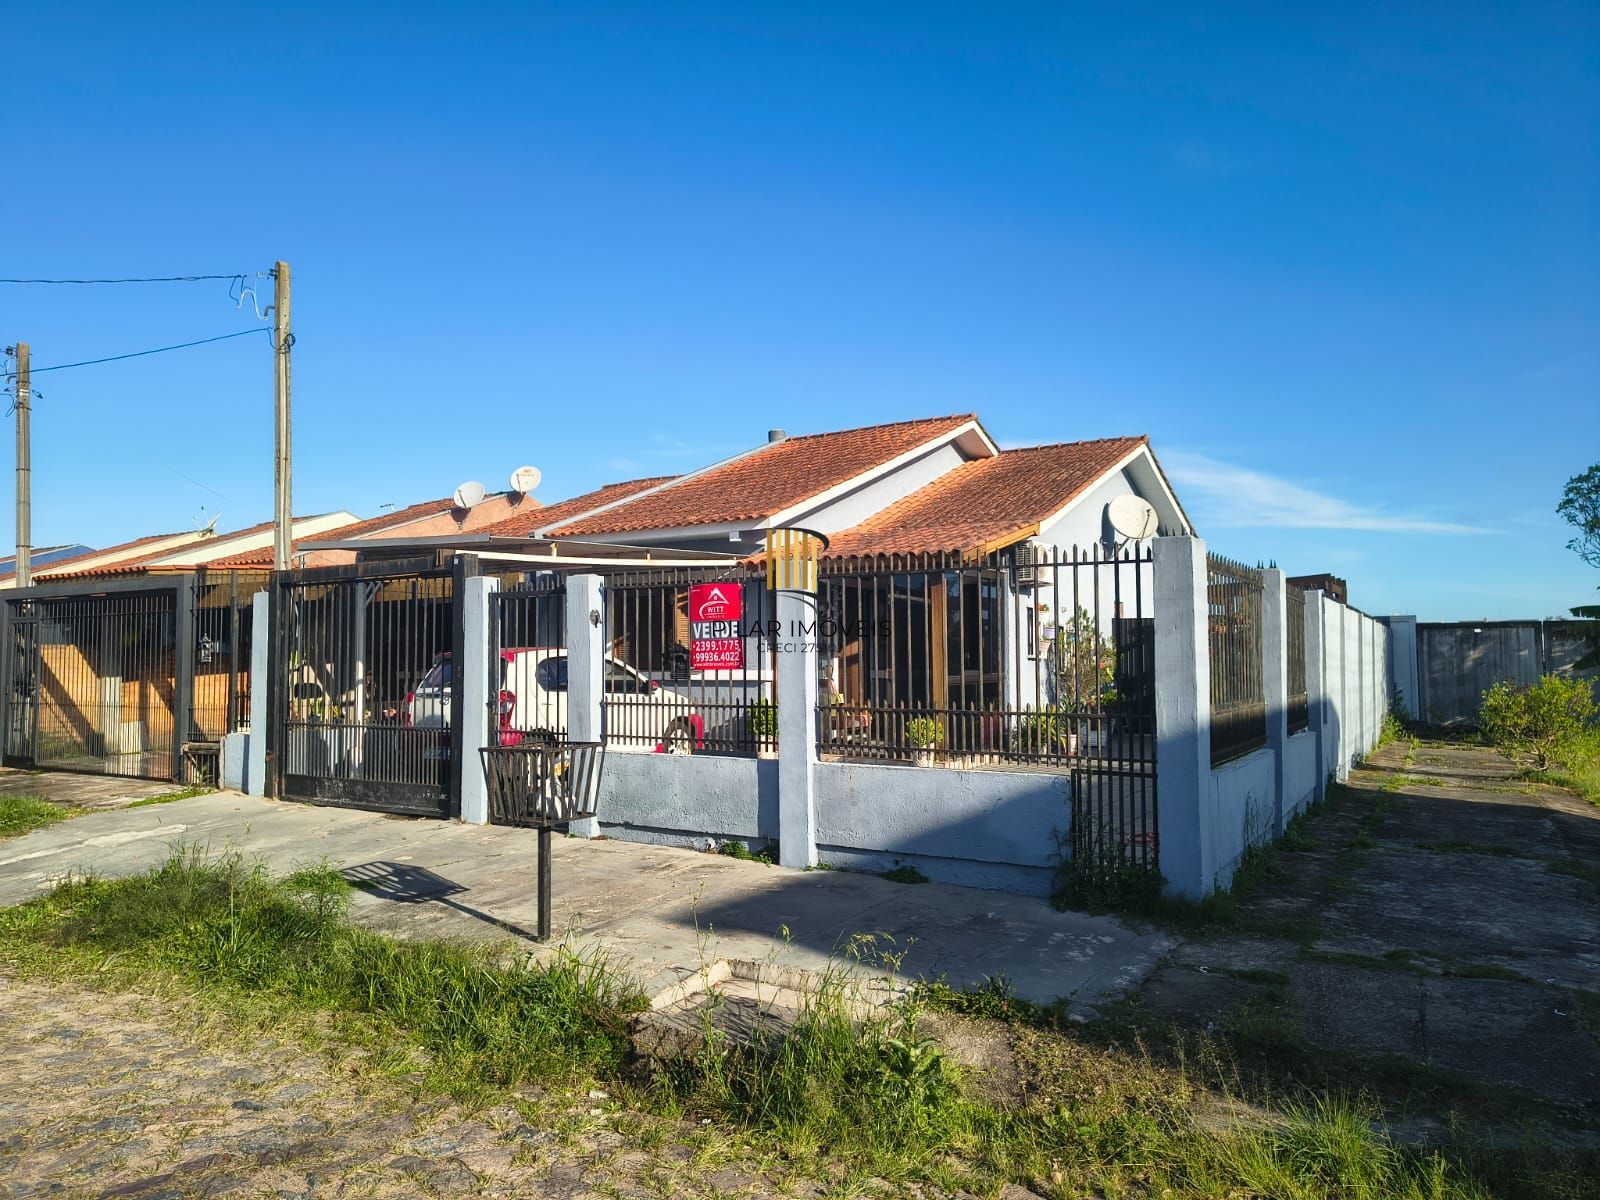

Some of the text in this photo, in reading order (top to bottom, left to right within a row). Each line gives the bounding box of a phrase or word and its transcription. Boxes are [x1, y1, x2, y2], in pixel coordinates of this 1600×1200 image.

[707, 605, 724, 613] WITT
[693, 621, 738, 639] VENDE
[695, 640, 739, 652] 2399.1775
[695, 652, 740, 662] 99936.4022
